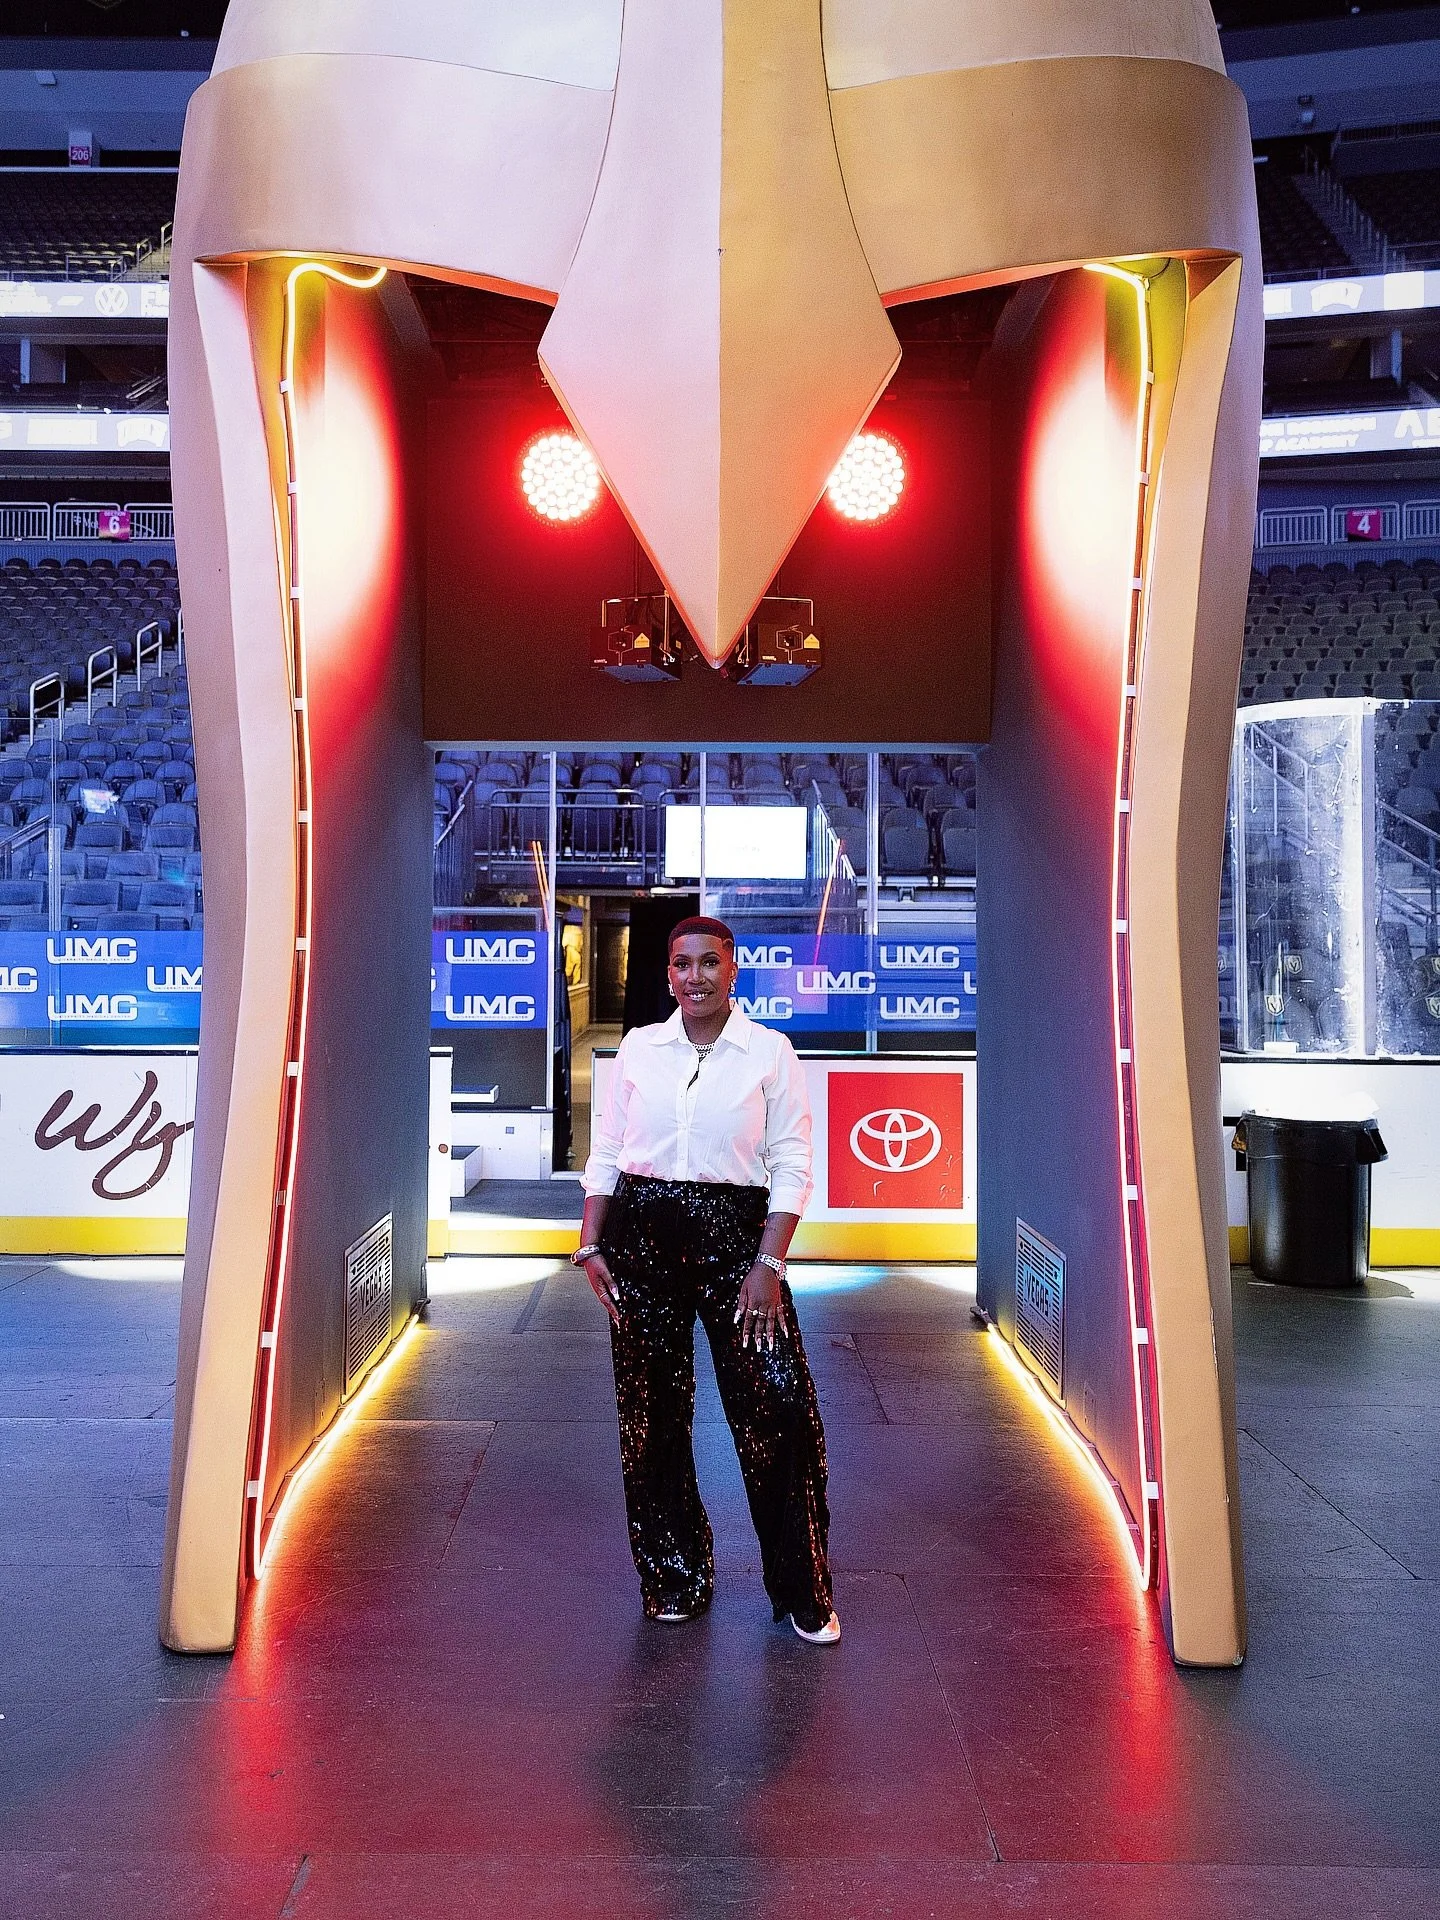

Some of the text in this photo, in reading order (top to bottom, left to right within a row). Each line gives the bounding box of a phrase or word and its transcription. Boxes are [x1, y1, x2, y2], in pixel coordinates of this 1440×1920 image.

[72, 150, 89, 160] 206
[109, 516, 120, 534] 6
[1357, 514, 1371, 534] 4
[46, 937, 138, 964] UMC
[445, 938, 536, 965] UMC
[733, 946, 793, 969] MC
[880, 945, 960, 969] UMC
[146, 966, 203, 993] UM
[796, 971, 876, 995] UMC
[47, 995, 138, 1021] UMC
[445, 995, 536, 1021] UMC
[730, 996, 793, 1020] MC
[880, 996, 960, 1020] UMC
[35, 1071, 195, 1200] Wy
[360, 1265, 382, 1314] VEGAS
[1026, 1270, 1049, 1317] VEGAS
